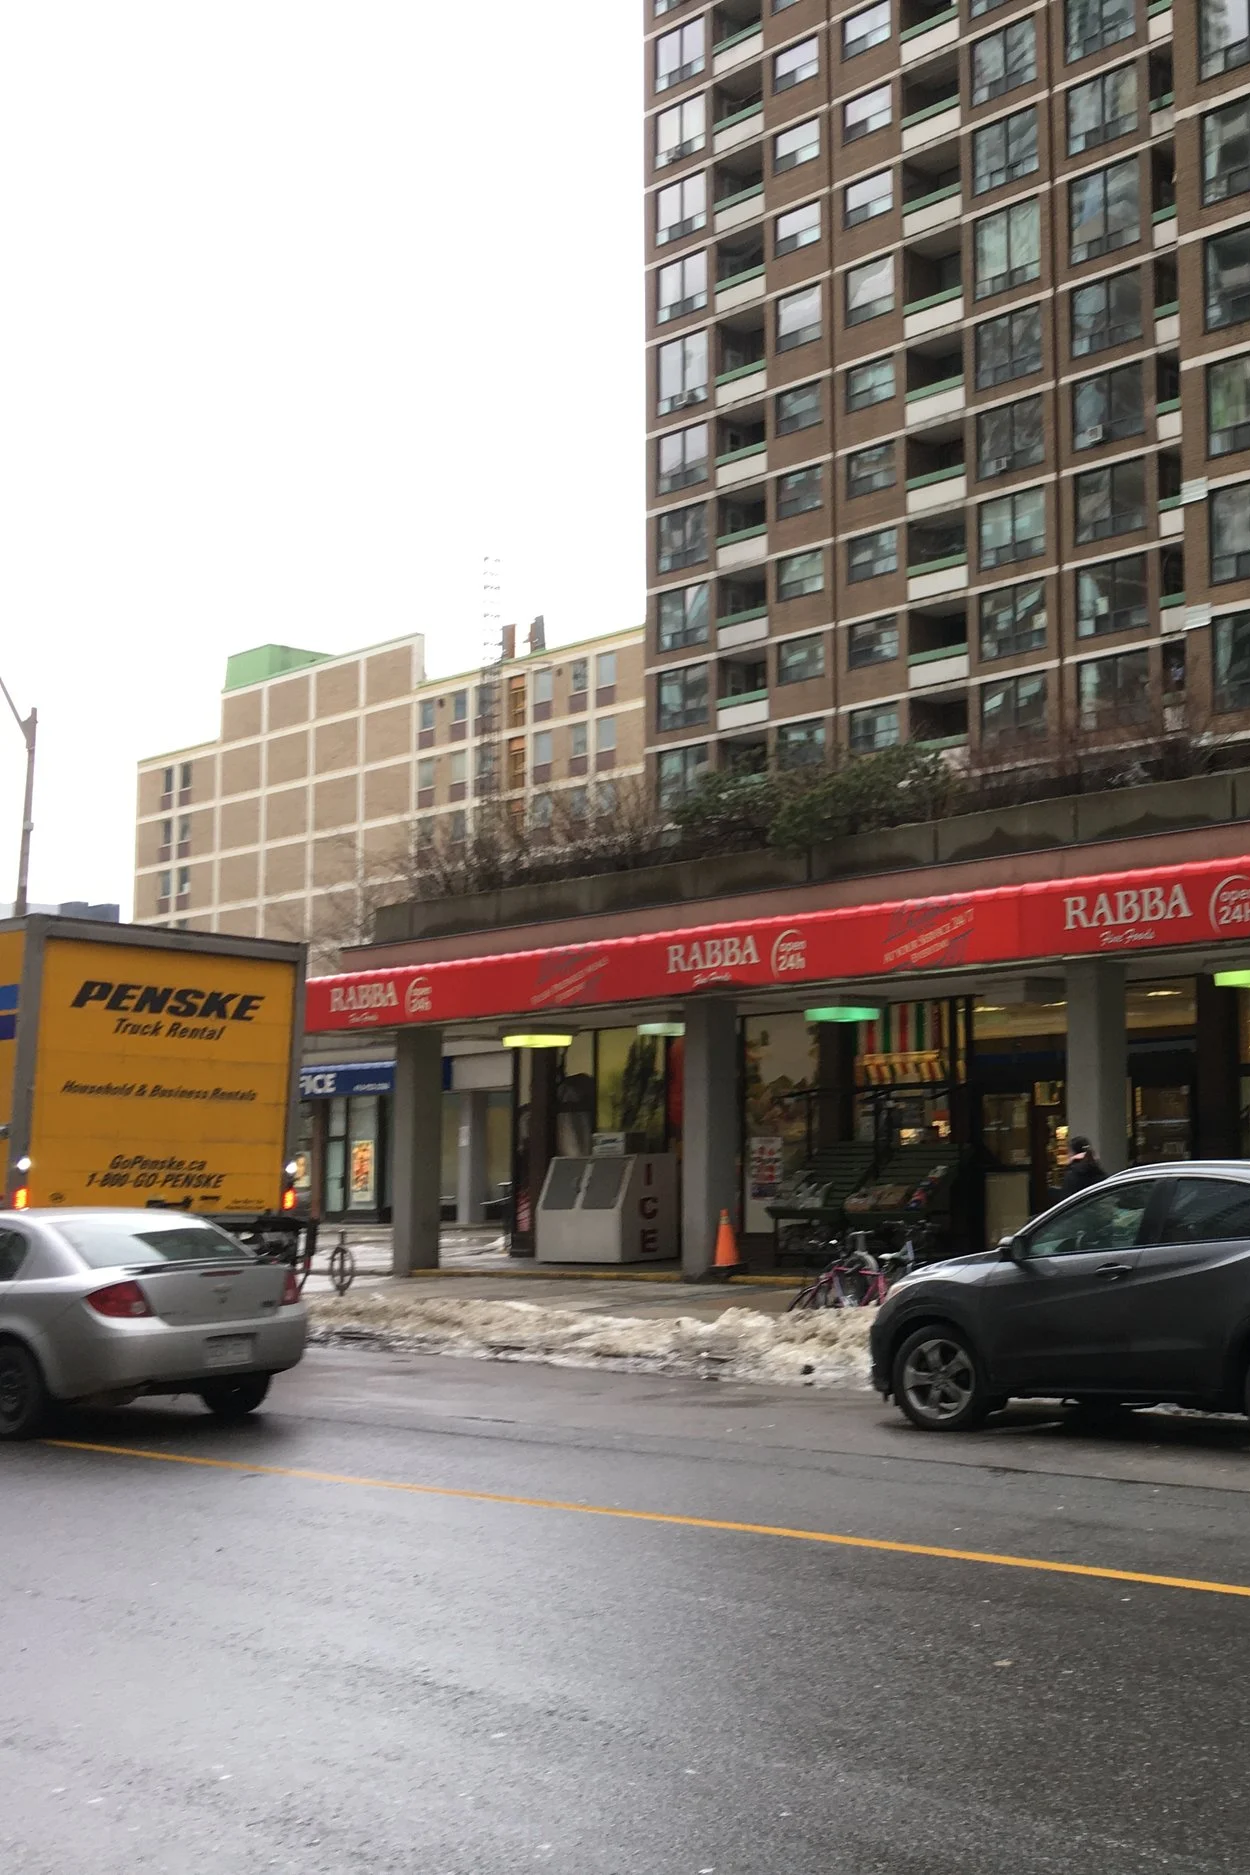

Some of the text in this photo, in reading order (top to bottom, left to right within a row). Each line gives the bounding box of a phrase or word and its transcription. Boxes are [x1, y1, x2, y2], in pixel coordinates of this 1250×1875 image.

[1063, 883, 1193, 931] RABBA
[666, 935, 760, 974] RABBA
[778, 940, 807, 952] open
[777, 952, 806, 971] 24h
[70, 980, 266, 1022] PENSKE
[329, 980, 400, 1013] RABBA
[112, 1017, 226, 1041] Truck Rental
[60, 1080, 258, 1101] Household & Business Rentals
[109, 1154, 208, 1171] GoPenske.ca
[86, 1172, 226, 1189] 1-800-GO-PENSKE
[638, 1163, 660, 1253] ICE
